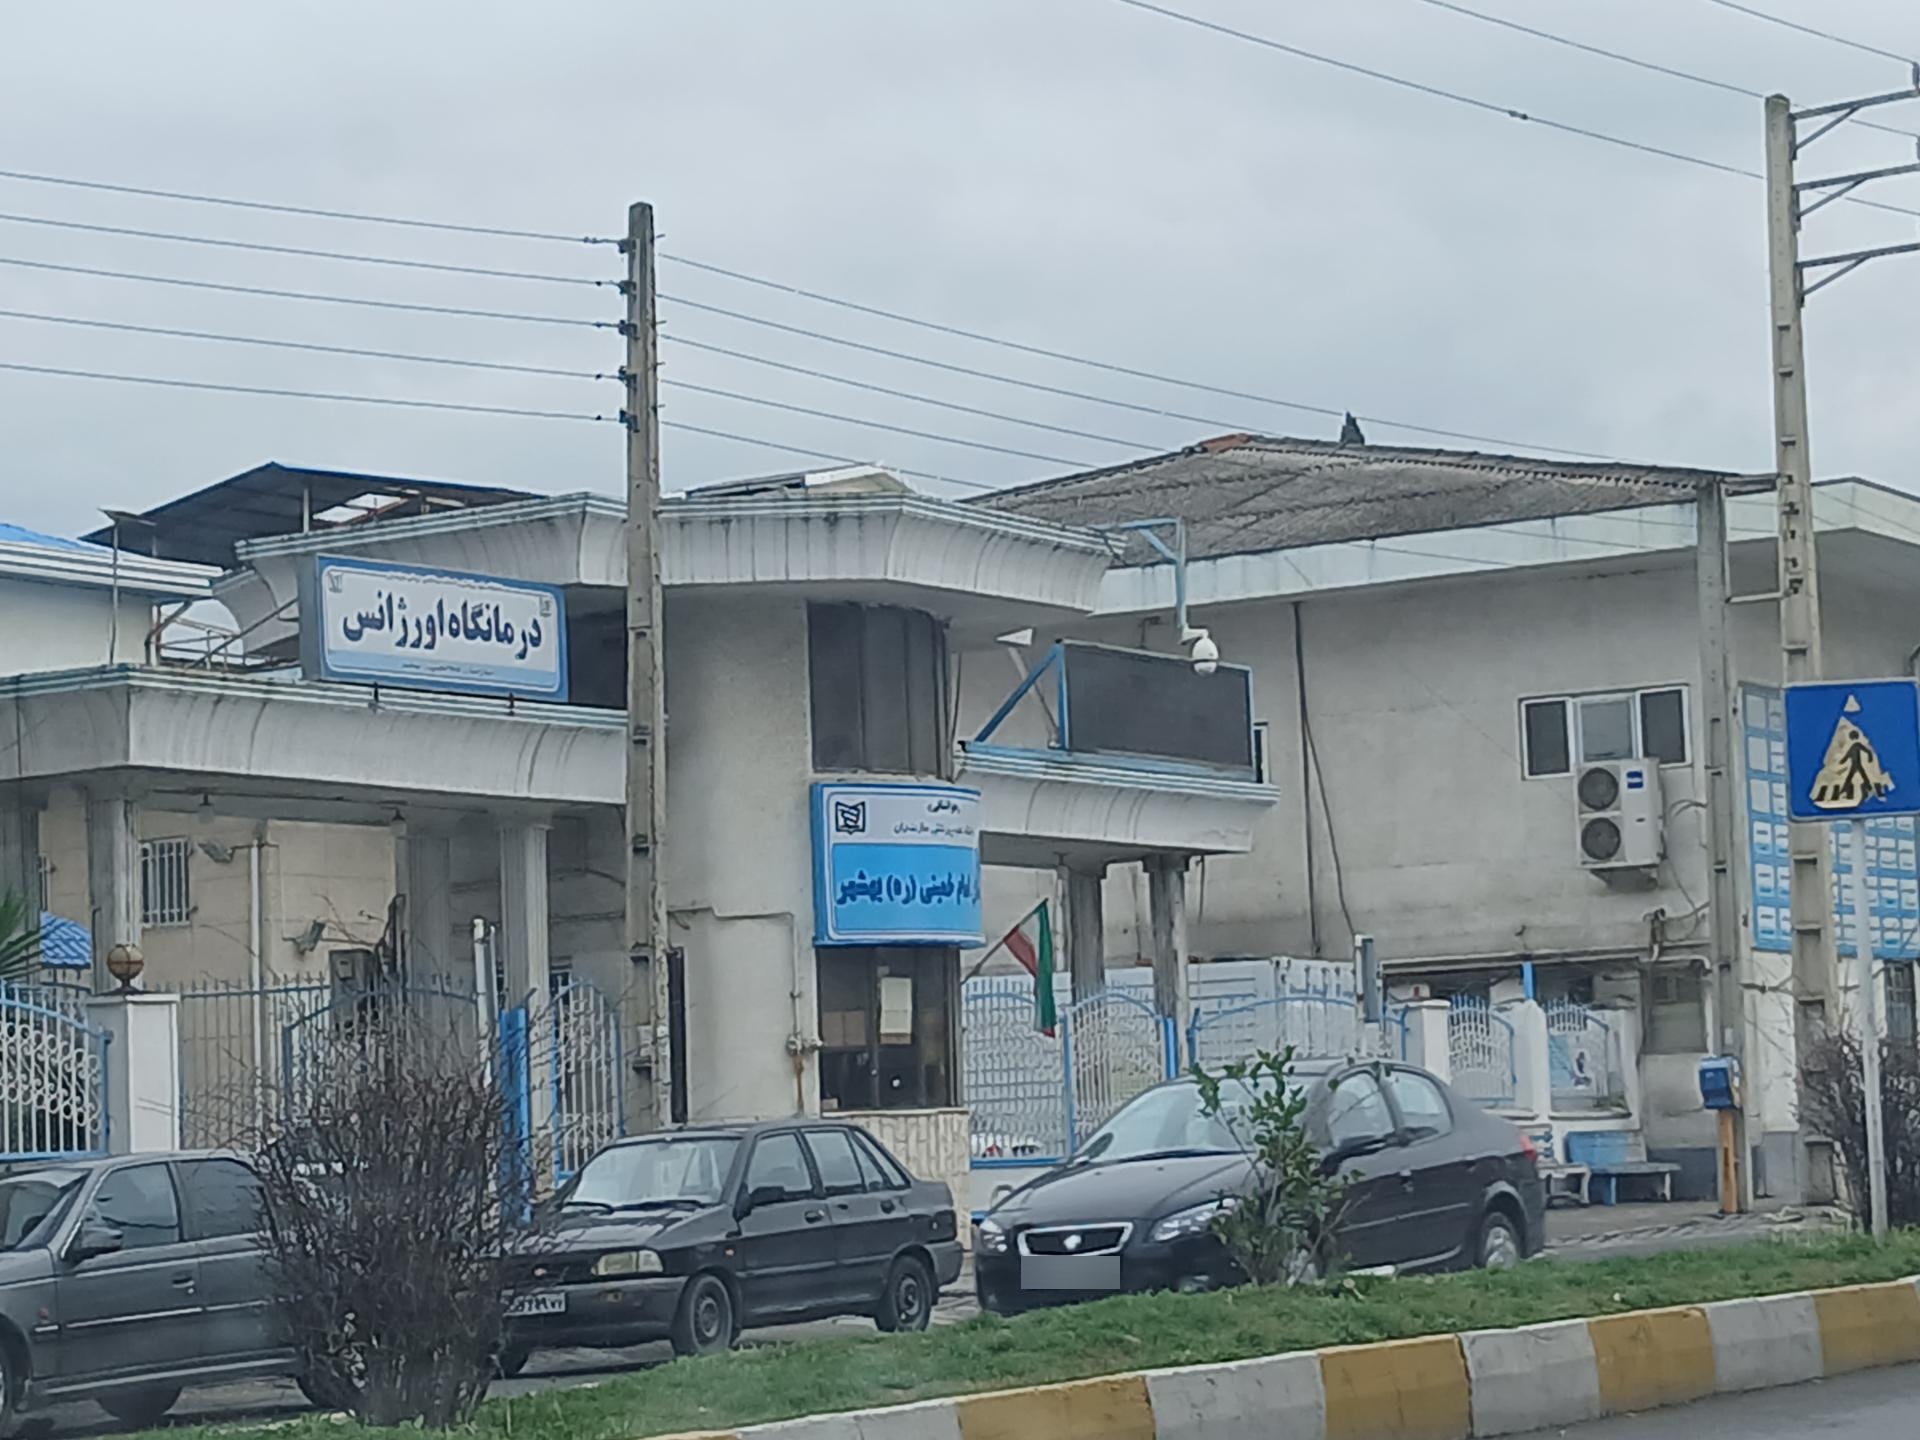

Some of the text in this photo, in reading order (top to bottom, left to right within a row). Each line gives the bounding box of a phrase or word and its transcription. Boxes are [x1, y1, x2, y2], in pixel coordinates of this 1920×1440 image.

[343, 590, 542, 660] درمانگاه اورژانس
[836, 870, 883, 905] بهشهر
[920, 872, 955, 905] خمینی
